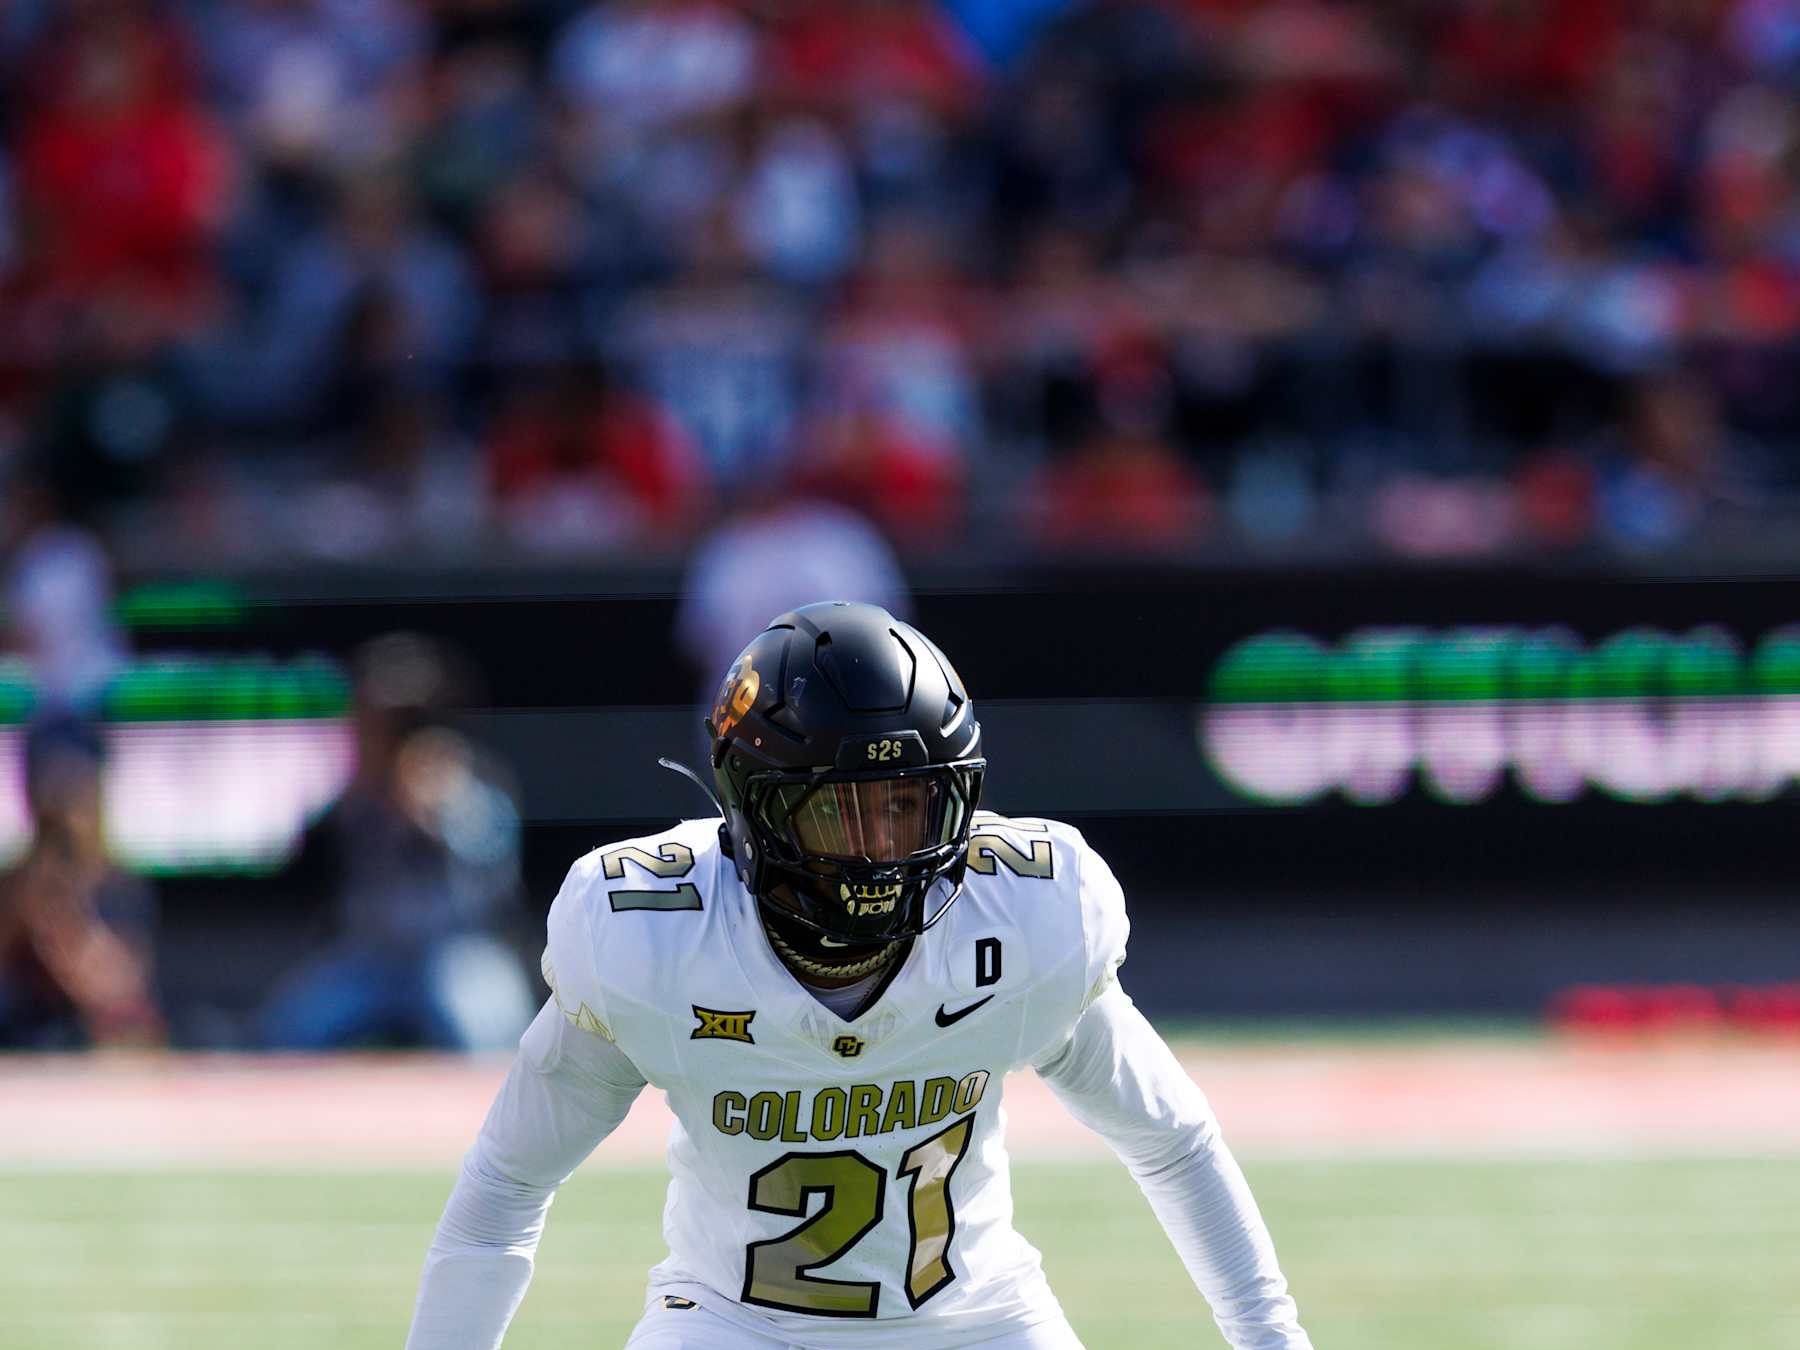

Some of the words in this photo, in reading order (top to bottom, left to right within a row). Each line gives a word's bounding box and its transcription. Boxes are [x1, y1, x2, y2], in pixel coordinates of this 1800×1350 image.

[601, 842, 704, 912] 21
[975, 936, 1002, 988] D
[712, 1069, 990, 1143] COLORADO
[740, 1111, 977, 1318] 21
